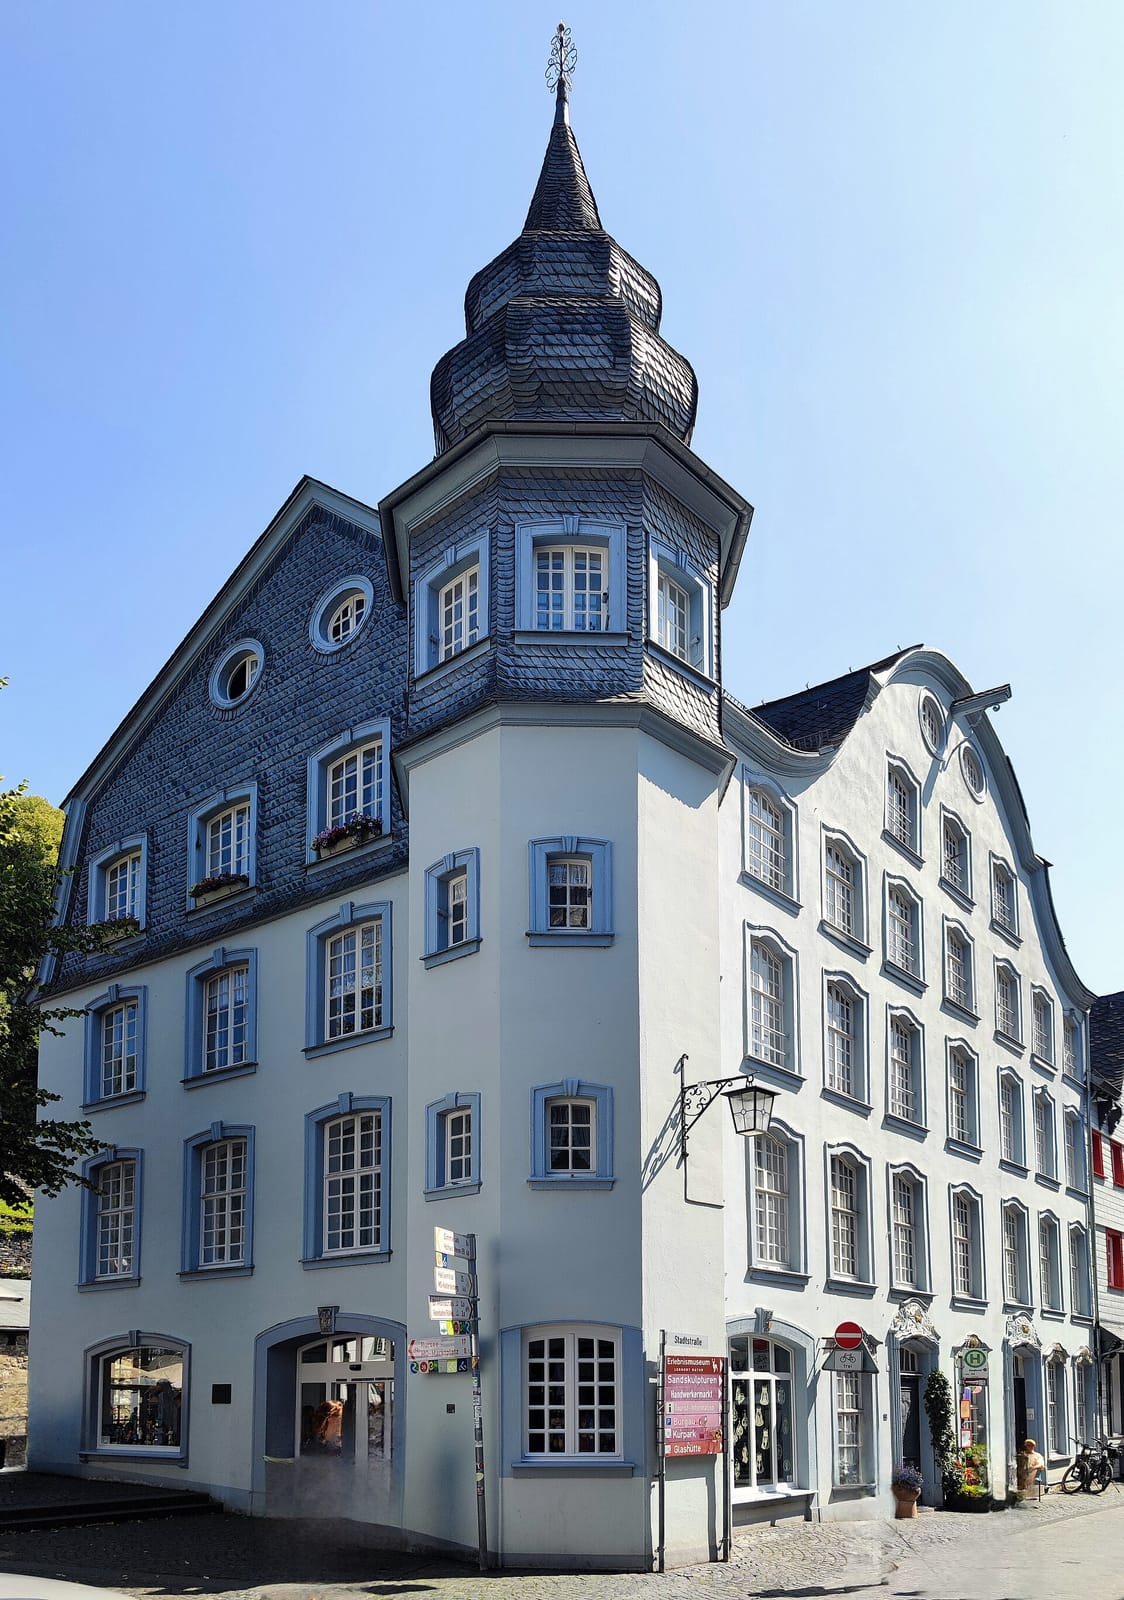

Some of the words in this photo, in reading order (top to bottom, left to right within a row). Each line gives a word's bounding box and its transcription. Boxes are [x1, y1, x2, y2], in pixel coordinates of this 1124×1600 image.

[674, 1335, 702, 1346] Stadtstraße
[667, 1357, 711, 1366] Erlebnismuseum
[970, 1353, 981, 1364] H
[667, 1374, 718, 1385] Sandskulpturen
[670, 1389, 713, 1399] Handwerkermarkt
[672, 1430, 697, 1440] Kurpark
[673, 1442, 702, 1454] Glashütte
